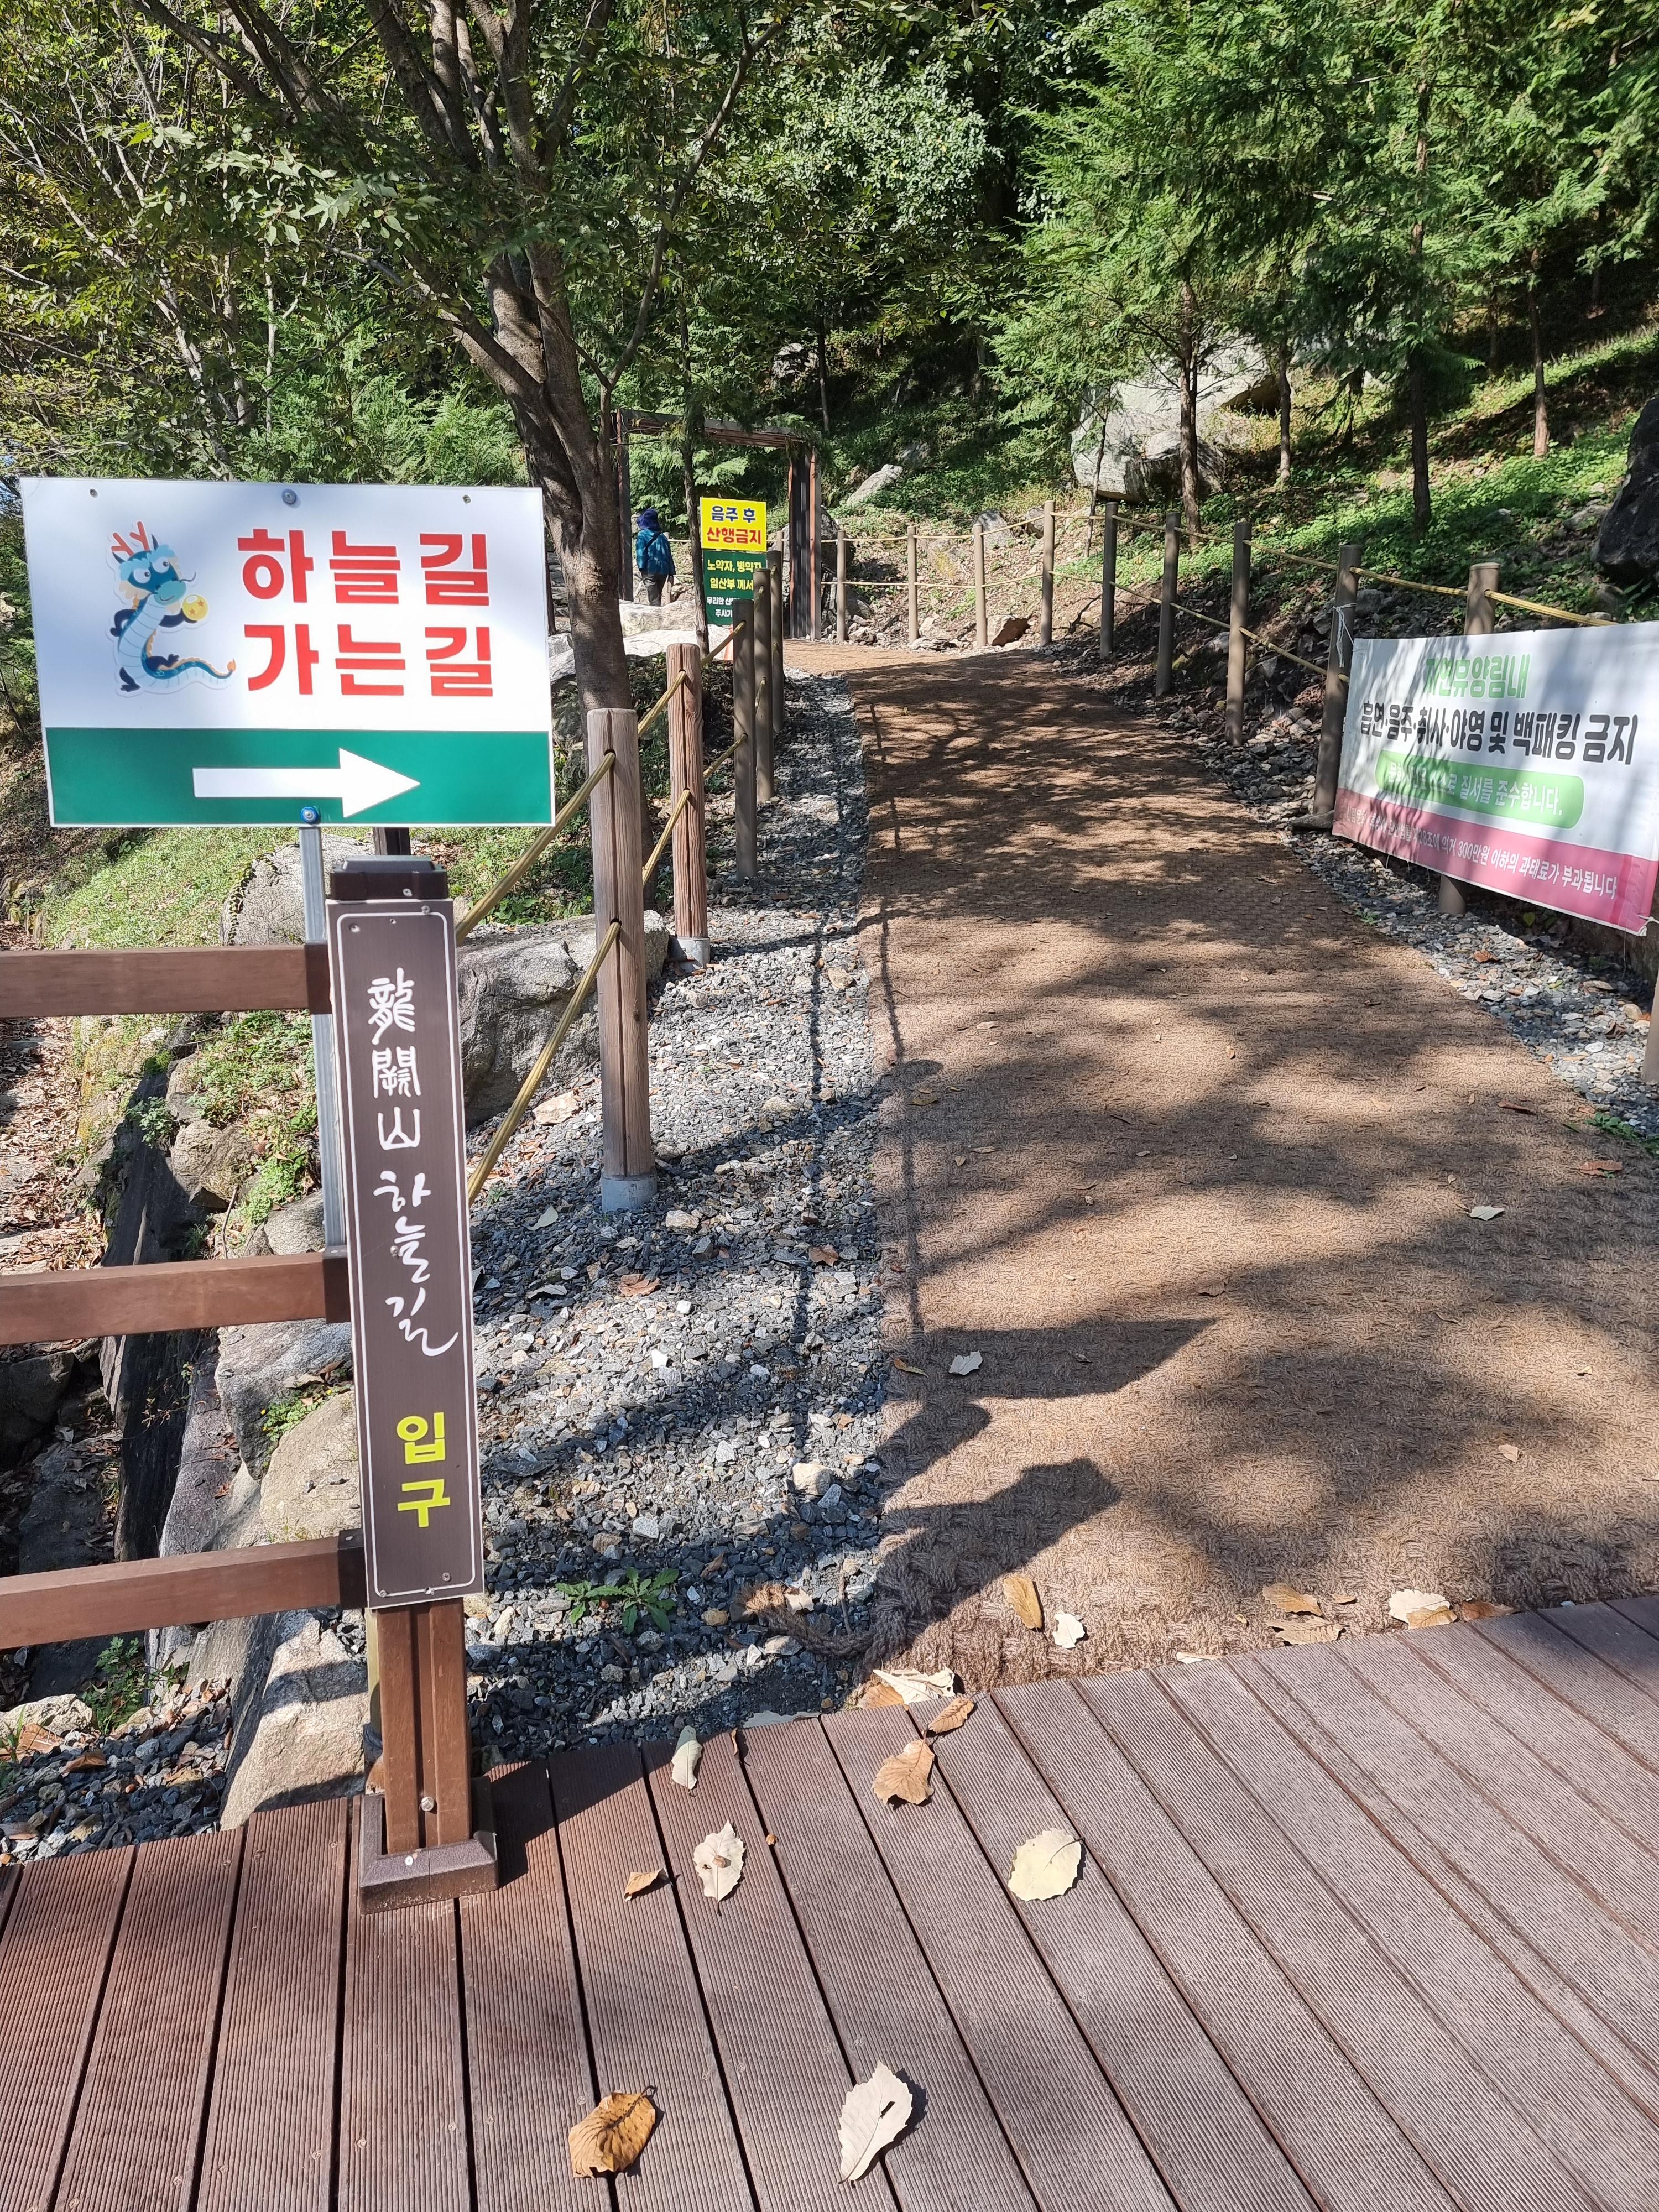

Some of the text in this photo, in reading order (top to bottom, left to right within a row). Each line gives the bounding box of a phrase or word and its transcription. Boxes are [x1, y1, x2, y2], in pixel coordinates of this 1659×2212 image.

[707, 527, 761, 545] 산행금지
[711, 505, 756, 523] 음주 후
[237, 528, 490, 607] 하늘길
[707, 559, 735, 573] 노약자,
[710, 577, 735, 590] 임산부
[707, 597, 724, 605] 무리한
[243, 623, 494, 697] 가는길
[1488, 711, 1509, 754] 및
[1512, 711, 1580, 760] 백패킹
[1583, 714, 1639, 765] 금지
[1460, 774, 1494, 805] 질서를
[1495, 780, 1563, 816] 준수합니다.
[1442, 834, 1457, 857] 의거
[1457, 842, 1490, 865] 300만원
[1491, 849, 1520, 874] 이하의
[1519, 856, 1560, 885] 과태료가
[1561, 865, 1618, 899] 부과됩니다
[373, 1170, 459, 1357] 하늘길
[396, 1411, 451, 1528] 입구
